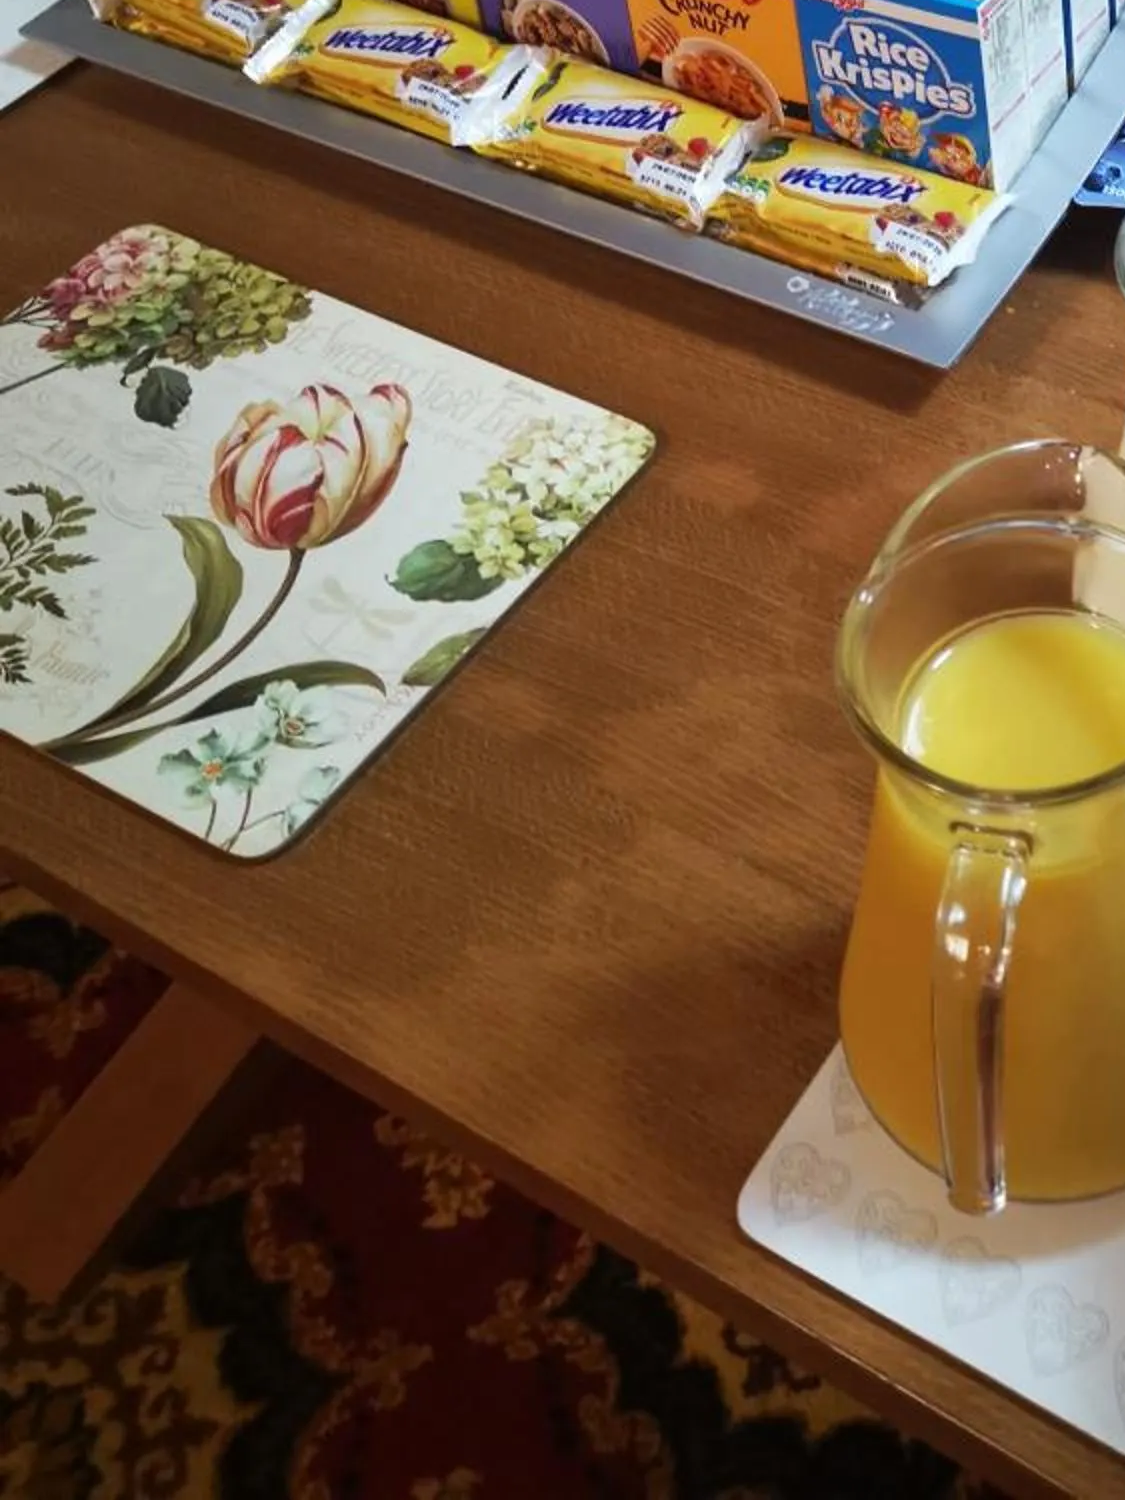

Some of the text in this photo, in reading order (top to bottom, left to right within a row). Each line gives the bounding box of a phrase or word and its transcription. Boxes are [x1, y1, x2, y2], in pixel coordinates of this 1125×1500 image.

[687, 13, 730, 36] NUT
[325, 29, 457, 58] Weetabix
[849, 22, 930, 73] Rice
[815, 46, 972, 114] Krispies
[546, 102, 685, 132] Weetabix
[779, 166, 928, 203] Weetabix
